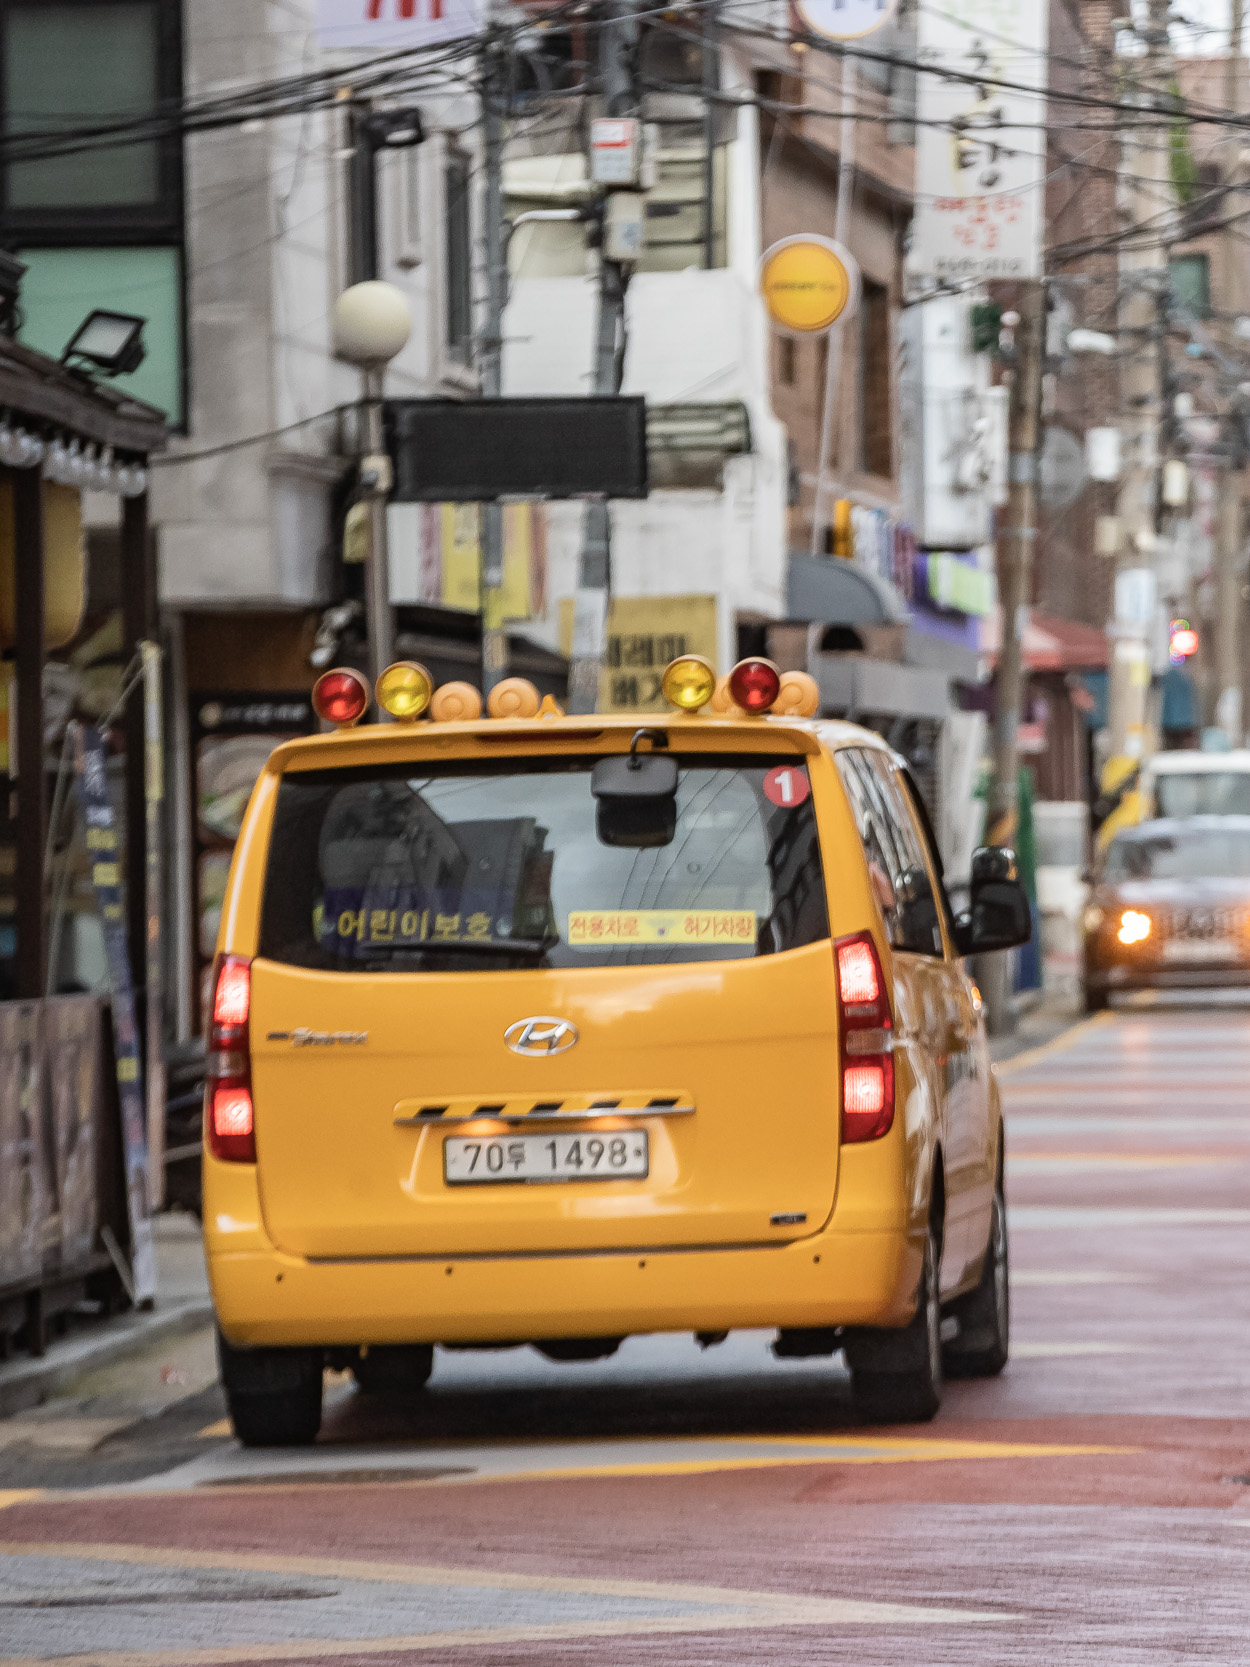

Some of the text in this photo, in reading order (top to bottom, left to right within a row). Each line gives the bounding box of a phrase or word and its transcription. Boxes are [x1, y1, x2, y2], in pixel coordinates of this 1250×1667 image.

[774, 770, 792, 803] 1
[571, 916, 752, 939] 전용차로 허가차량
[544, 1138, 628, 1170] 1498
